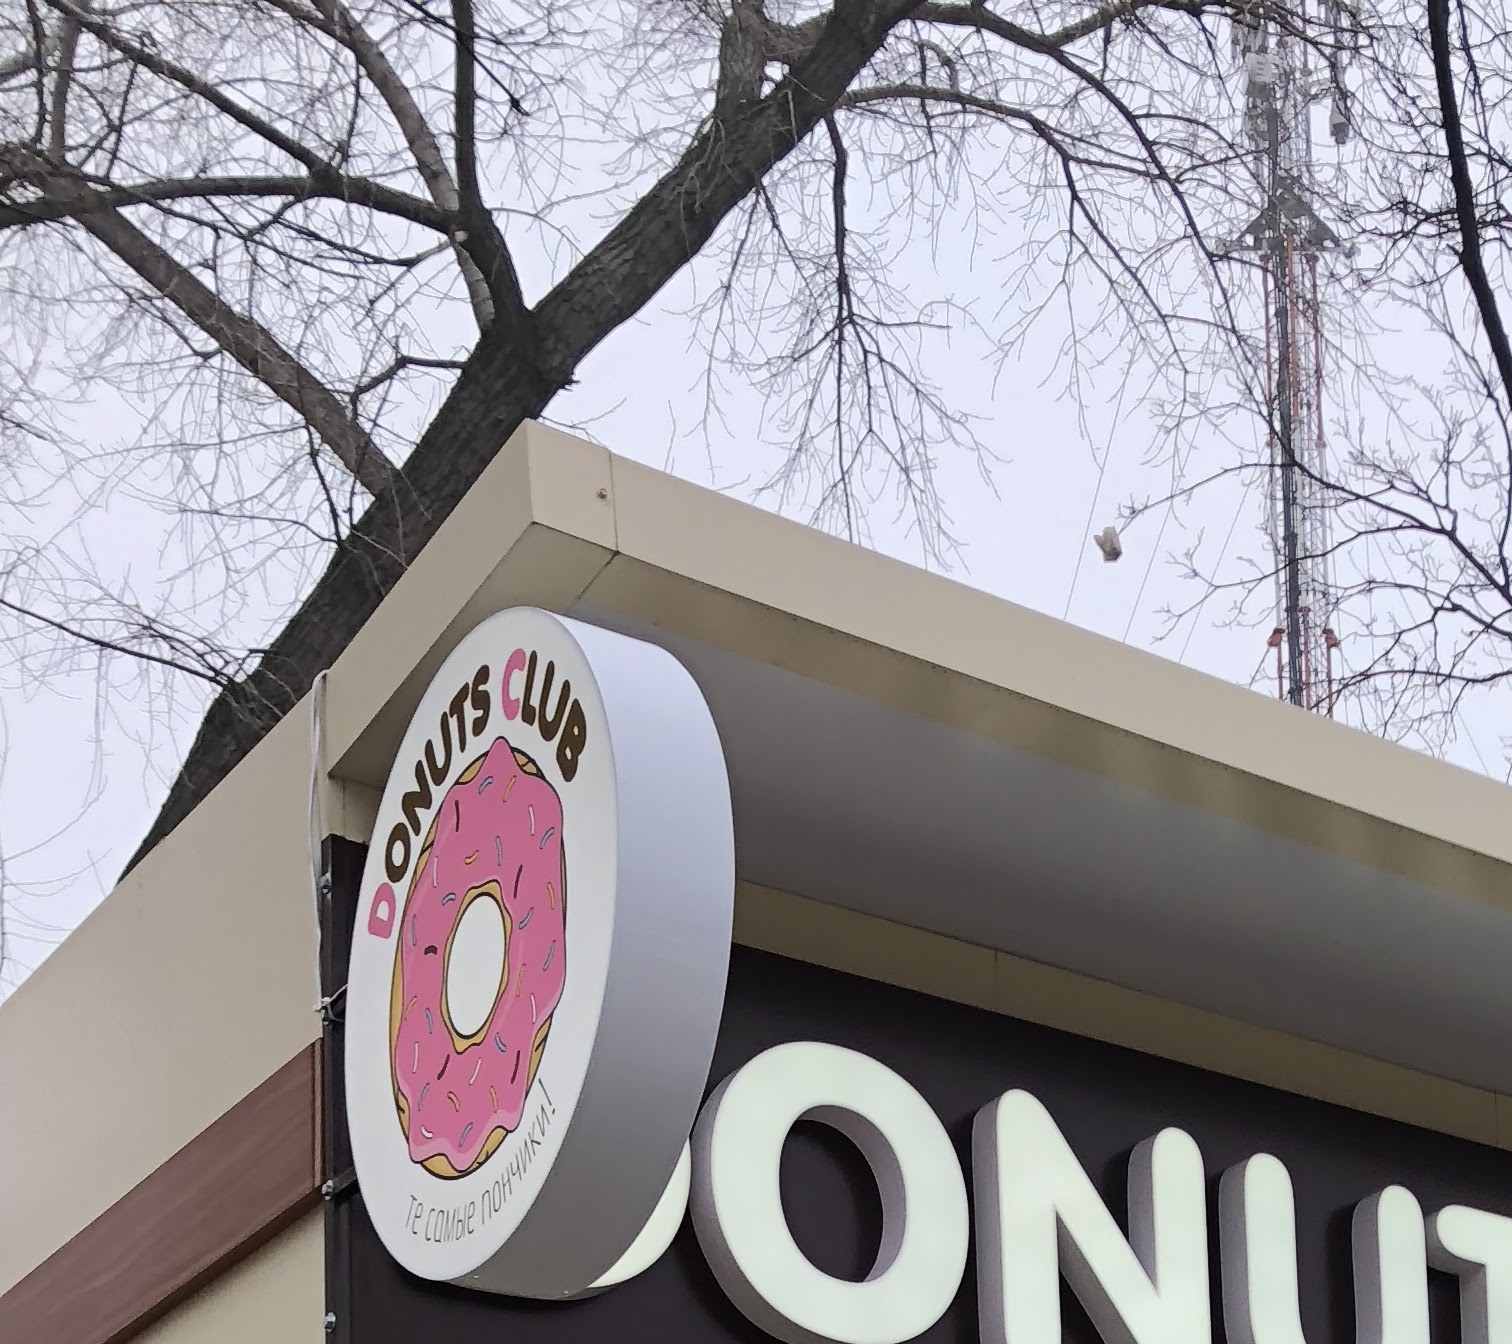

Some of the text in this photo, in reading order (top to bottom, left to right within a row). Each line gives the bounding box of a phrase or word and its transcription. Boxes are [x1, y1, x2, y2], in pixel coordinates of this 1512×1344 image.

[367, 648, 587, 940] DONUTS CLUB
[404, 1078, 556, 1243] Те самые пончики!
